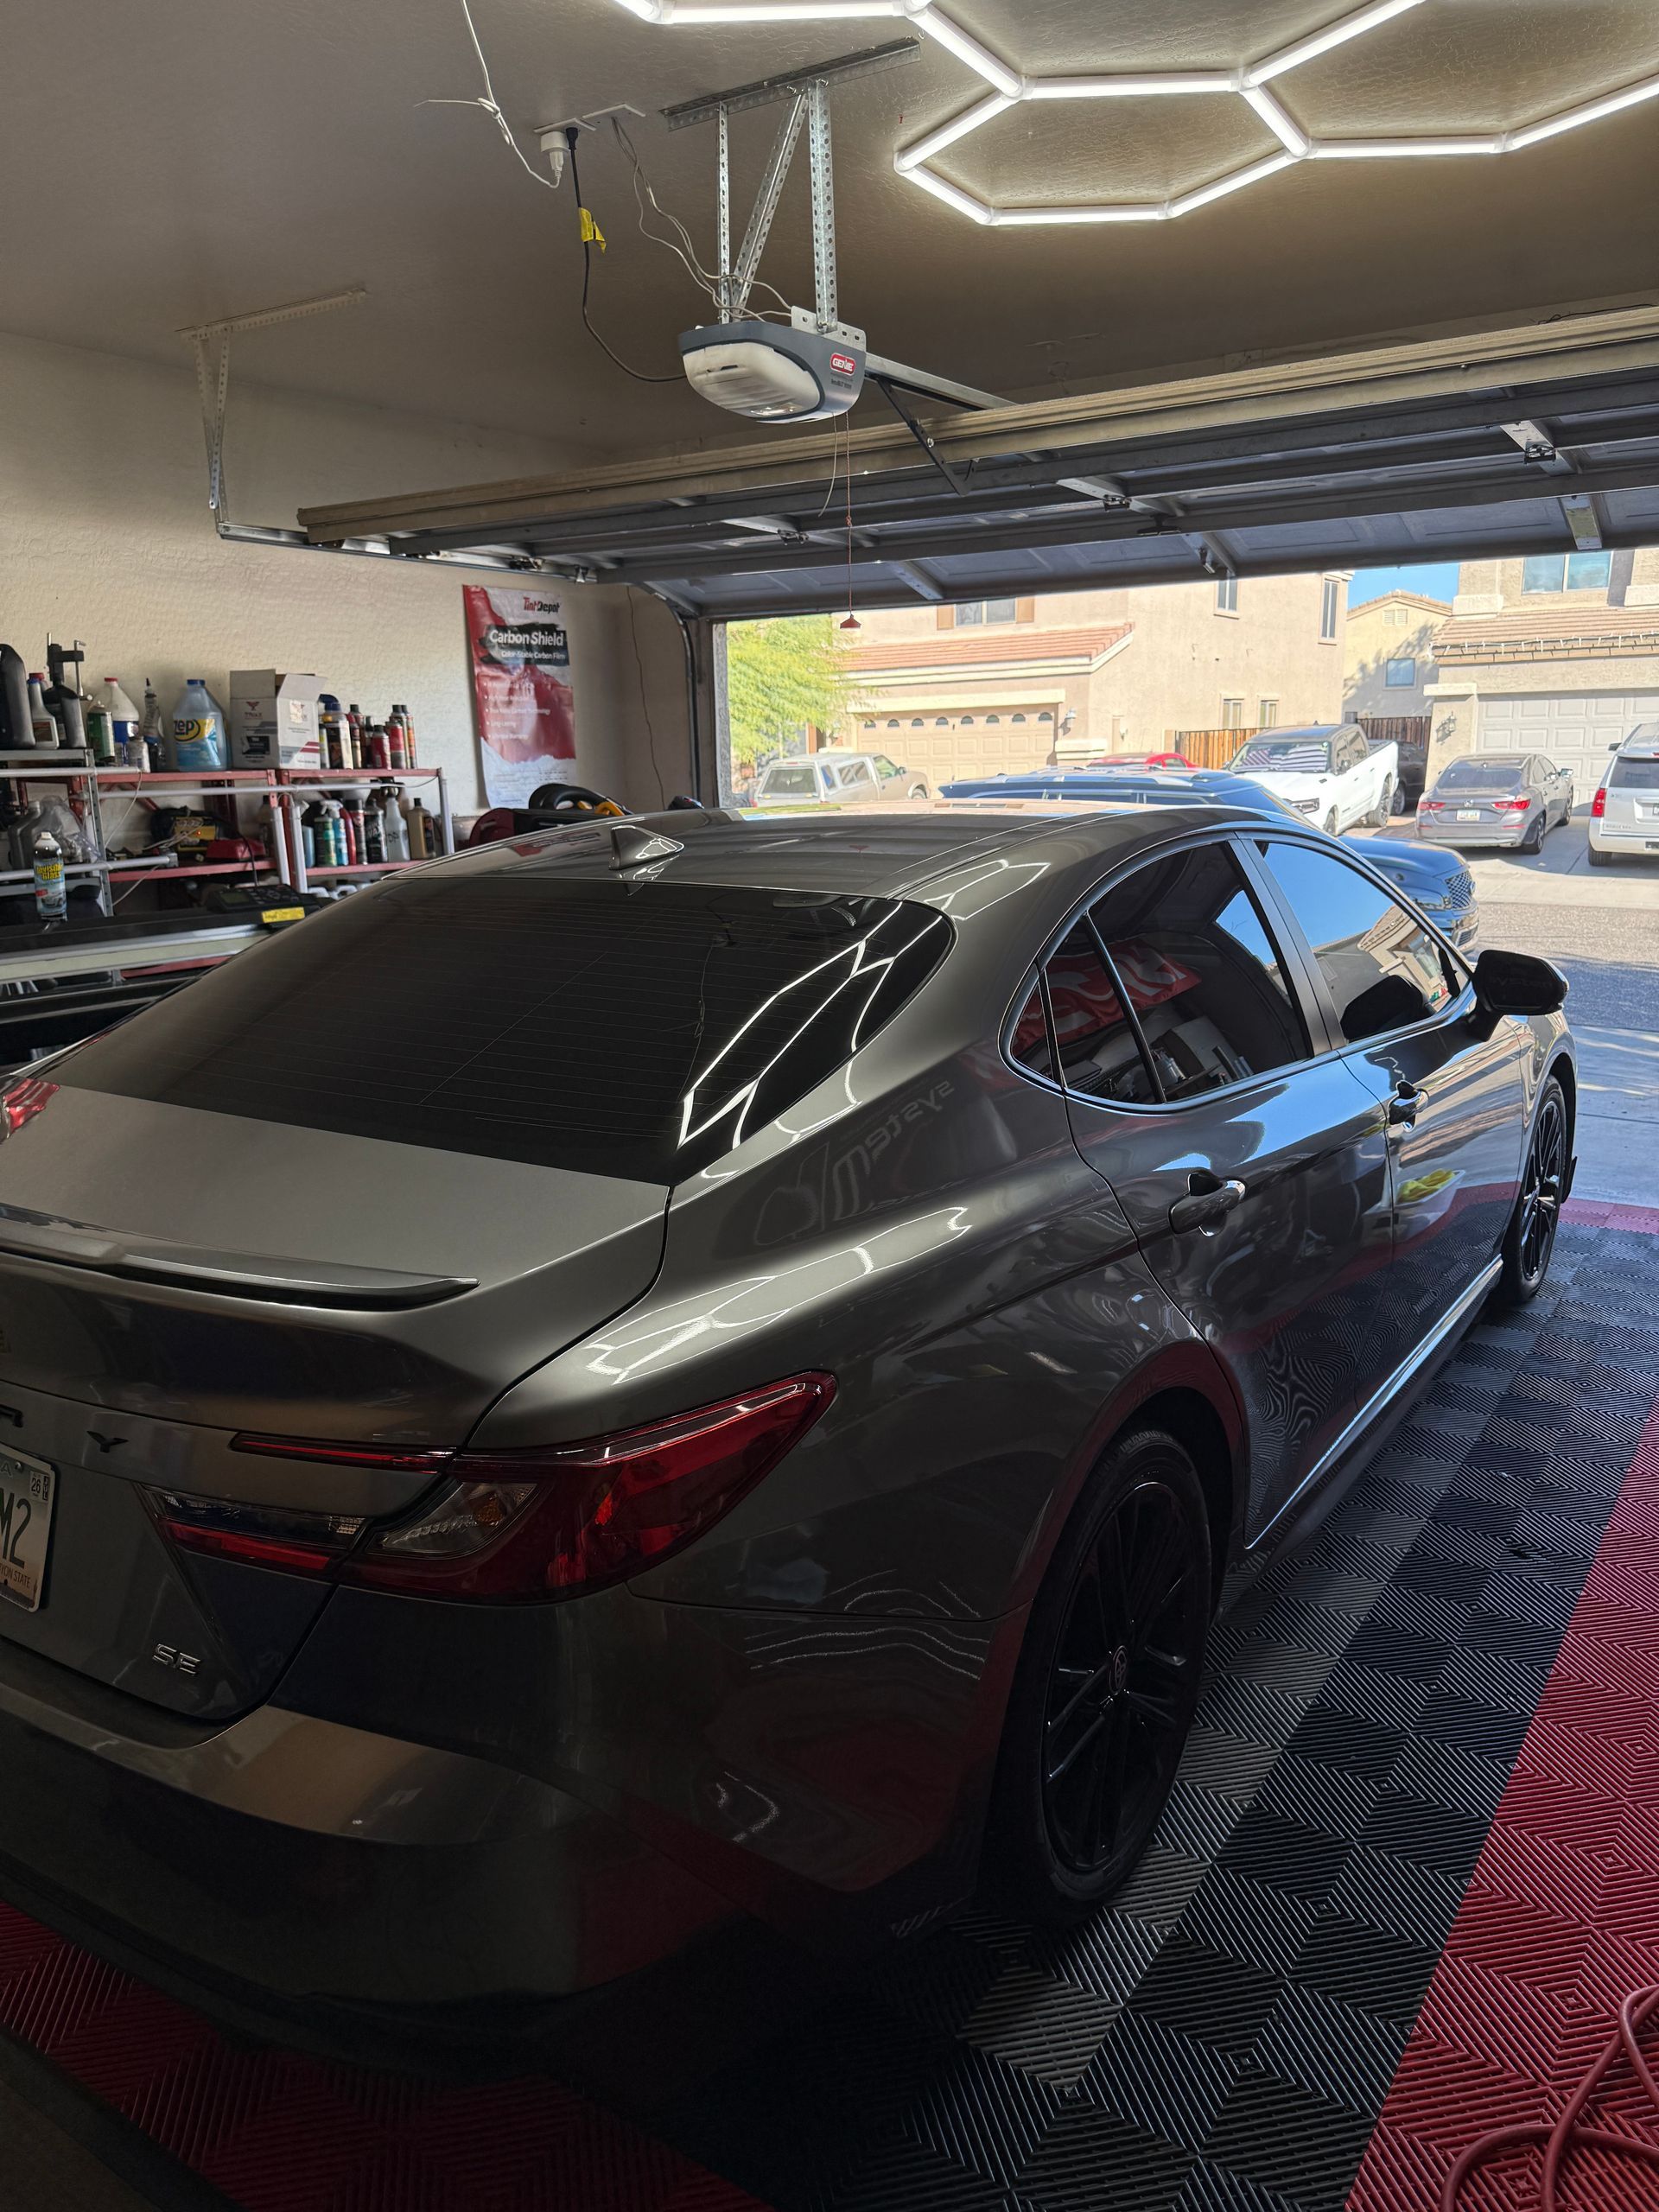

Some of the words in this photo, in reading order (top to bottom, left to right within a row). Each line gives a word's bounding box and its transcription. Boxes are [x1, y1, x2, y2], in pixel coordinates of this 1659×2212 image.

[489, 629, 530, 645] Carbon
[531, 631, 564, 646] Shield
[31, 1478, 41, 1493] 26
[13, 1569, 31, 1588] STATE
[152, 1643, 202, 1675] SE
